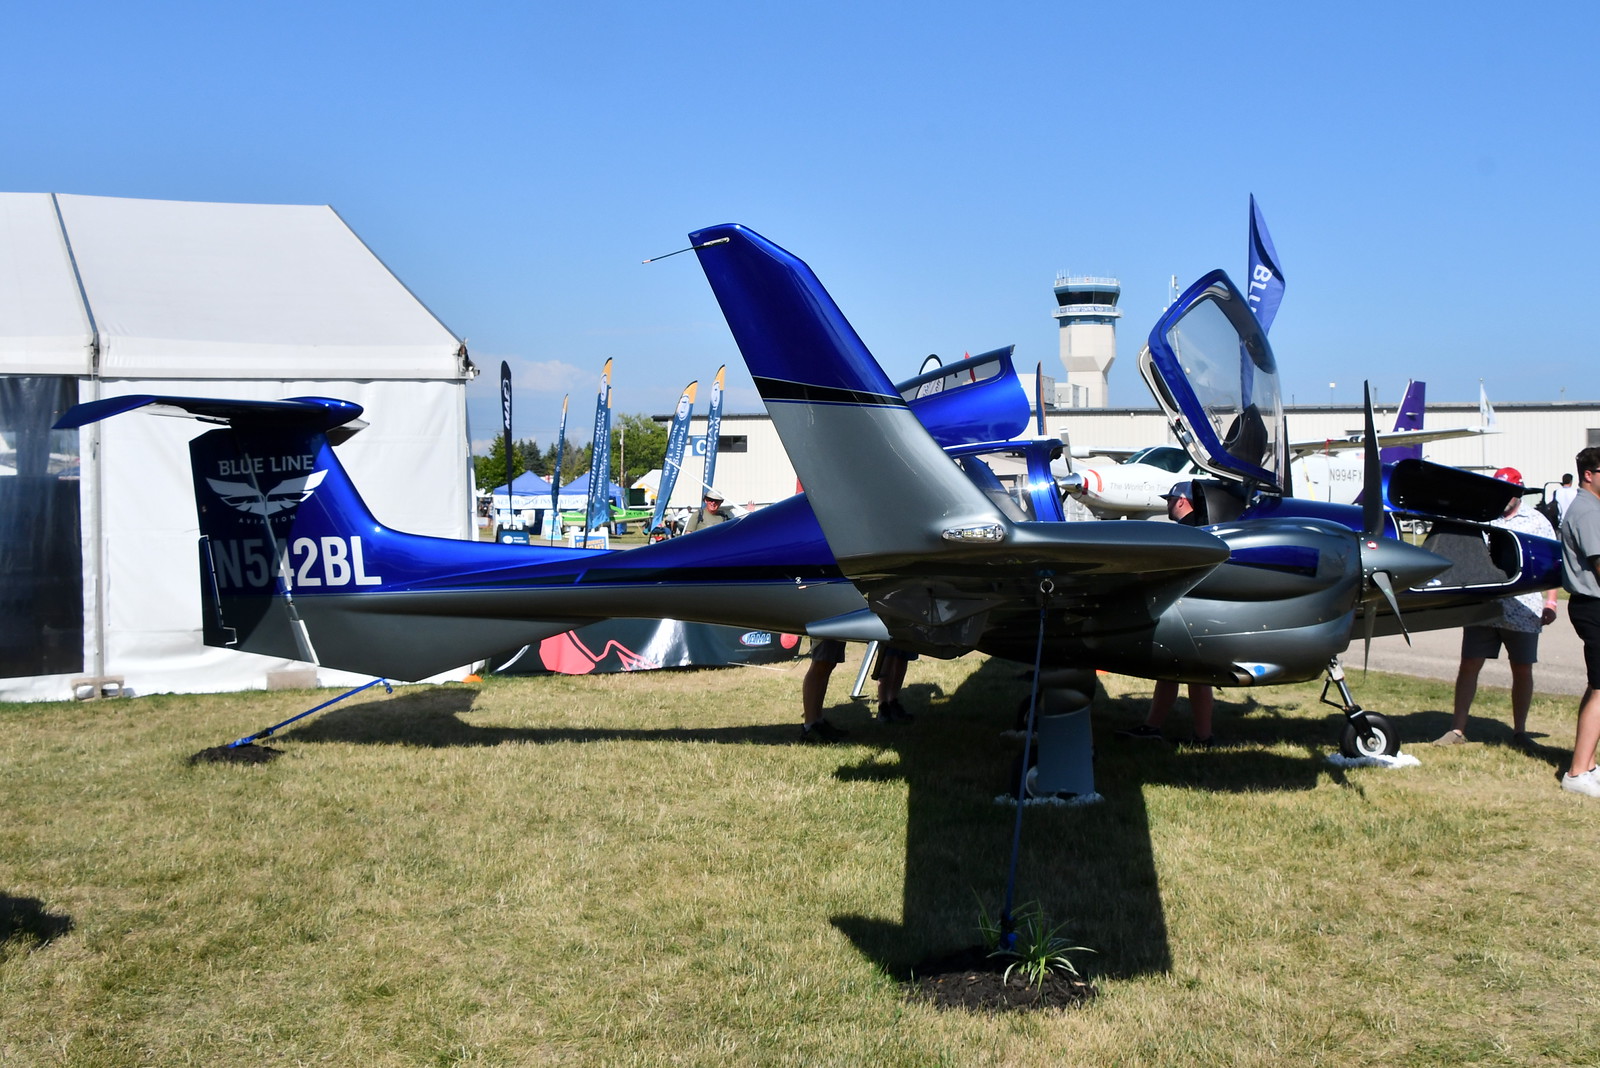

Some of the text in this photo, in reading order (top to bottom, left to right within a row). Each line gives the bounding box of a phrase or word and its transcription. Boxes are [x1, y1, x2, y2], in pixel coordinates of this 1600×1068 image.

[673, 425, 687, 465] Training
[704, 415, 714, 484] Aviation
[217, 455, 314, 476] BLUE LINE
[1329, 469, 1363, 481] N994FX
[1110, 482, 1122, 490] The
[1124, 482, 1143, 491] World
[238, 514, 296, 525] AVIATION
[213, 536, 382, 588] N542BL
